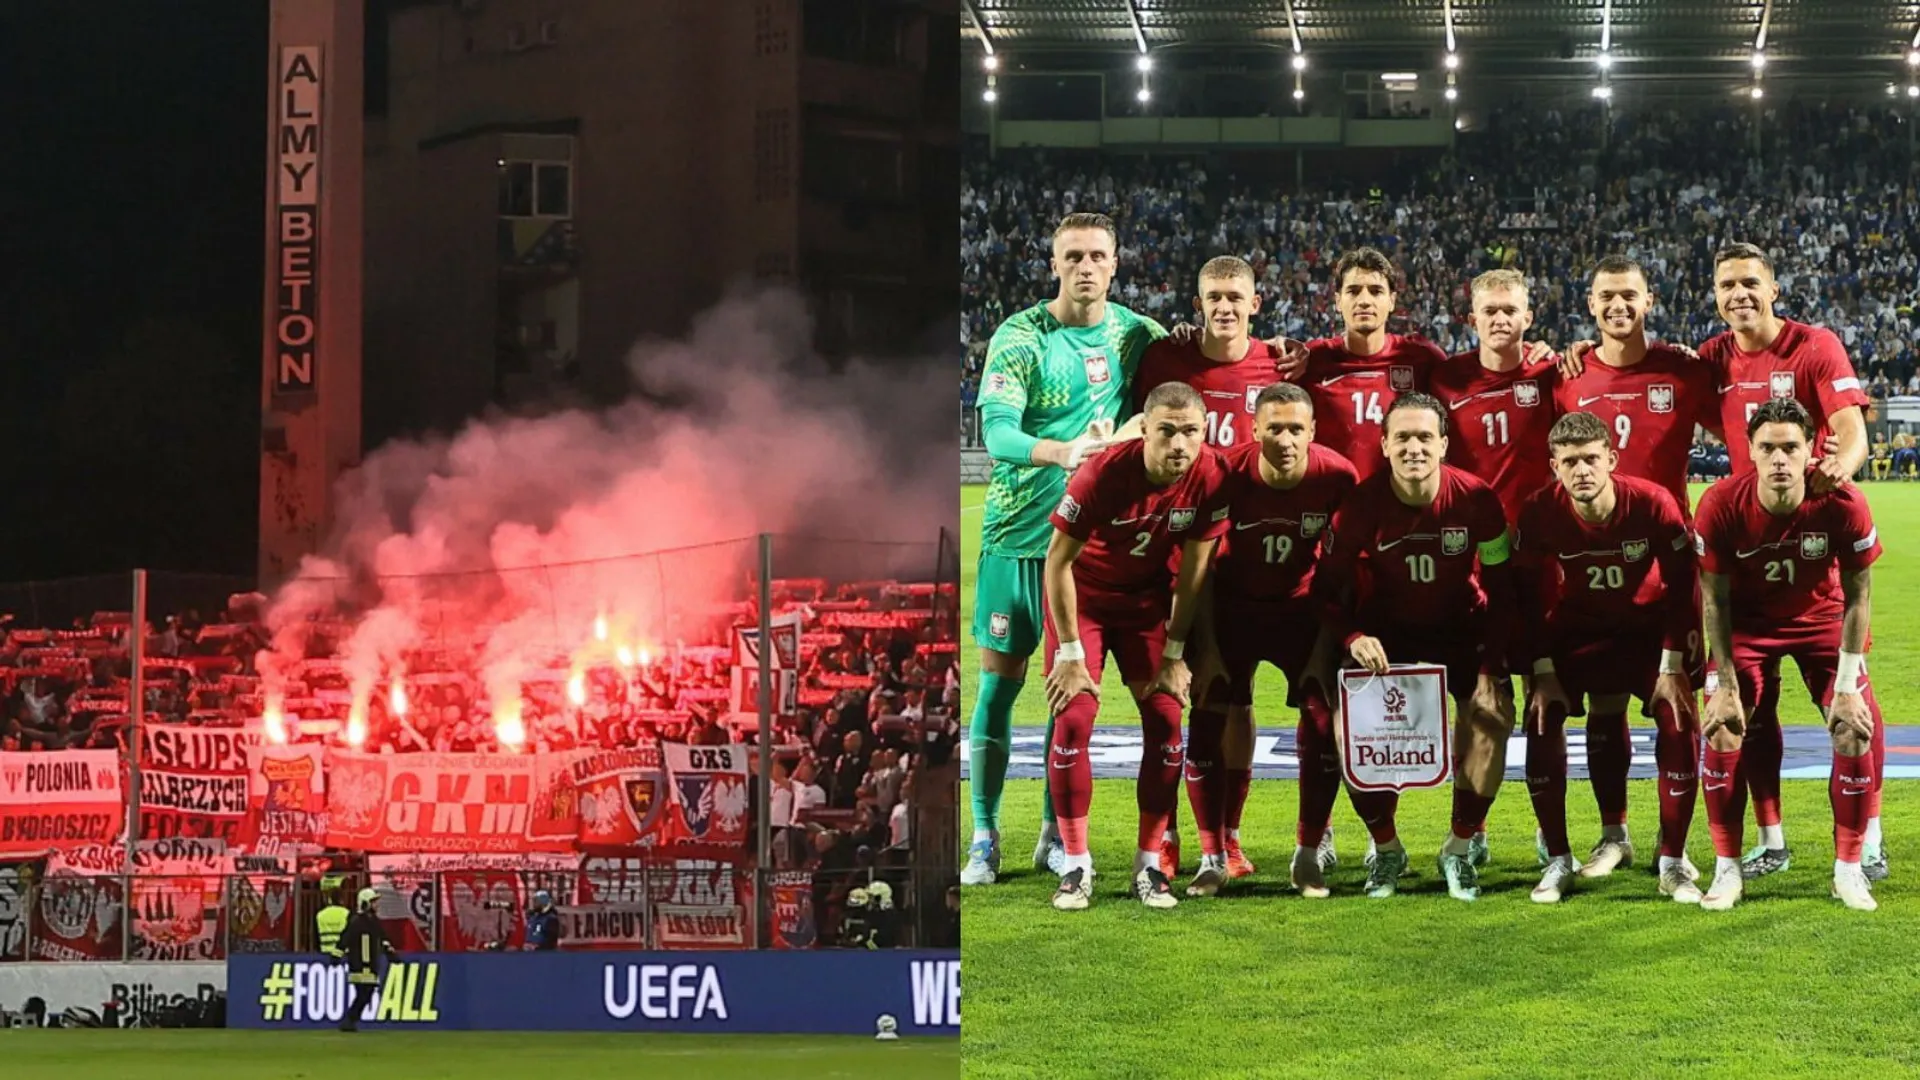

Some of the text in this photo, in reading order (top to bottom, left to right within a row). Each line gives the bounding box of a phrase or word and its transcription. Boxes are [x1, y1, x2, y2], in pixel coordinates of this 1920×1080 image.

[278, 53, 318, 385] ALMY BETON
[1351, 392, 1383, 424] 14
[1206, 411, 1235, 447] 16
[1481, 411, 1509, 446] 11
[1615, 414, 1631, 449] 9
[1130, 532, 1152, 556] 2
[1262, 535, 1293, 563] 19
[1405, 554, 1436, 583] 10
[1586, 565, 1624, 588] 20
[1764, 558, 1795, 585] 21
[689, 749, 732, 769] GKS
[1355, 744, 1437, 767] Poland
[25, 762, 92, 793] POLONIA
[1839, 774, 1871, 785] POLSKA
[386, 772, 530, 834] GKM
[2, 813, 111, 841] BYDGOSZCZ
[261, 963, 439, 1020] #FOOALL
[604, 965, 728, 1019] UEFA
[911, 961, 960, 1025] WE
